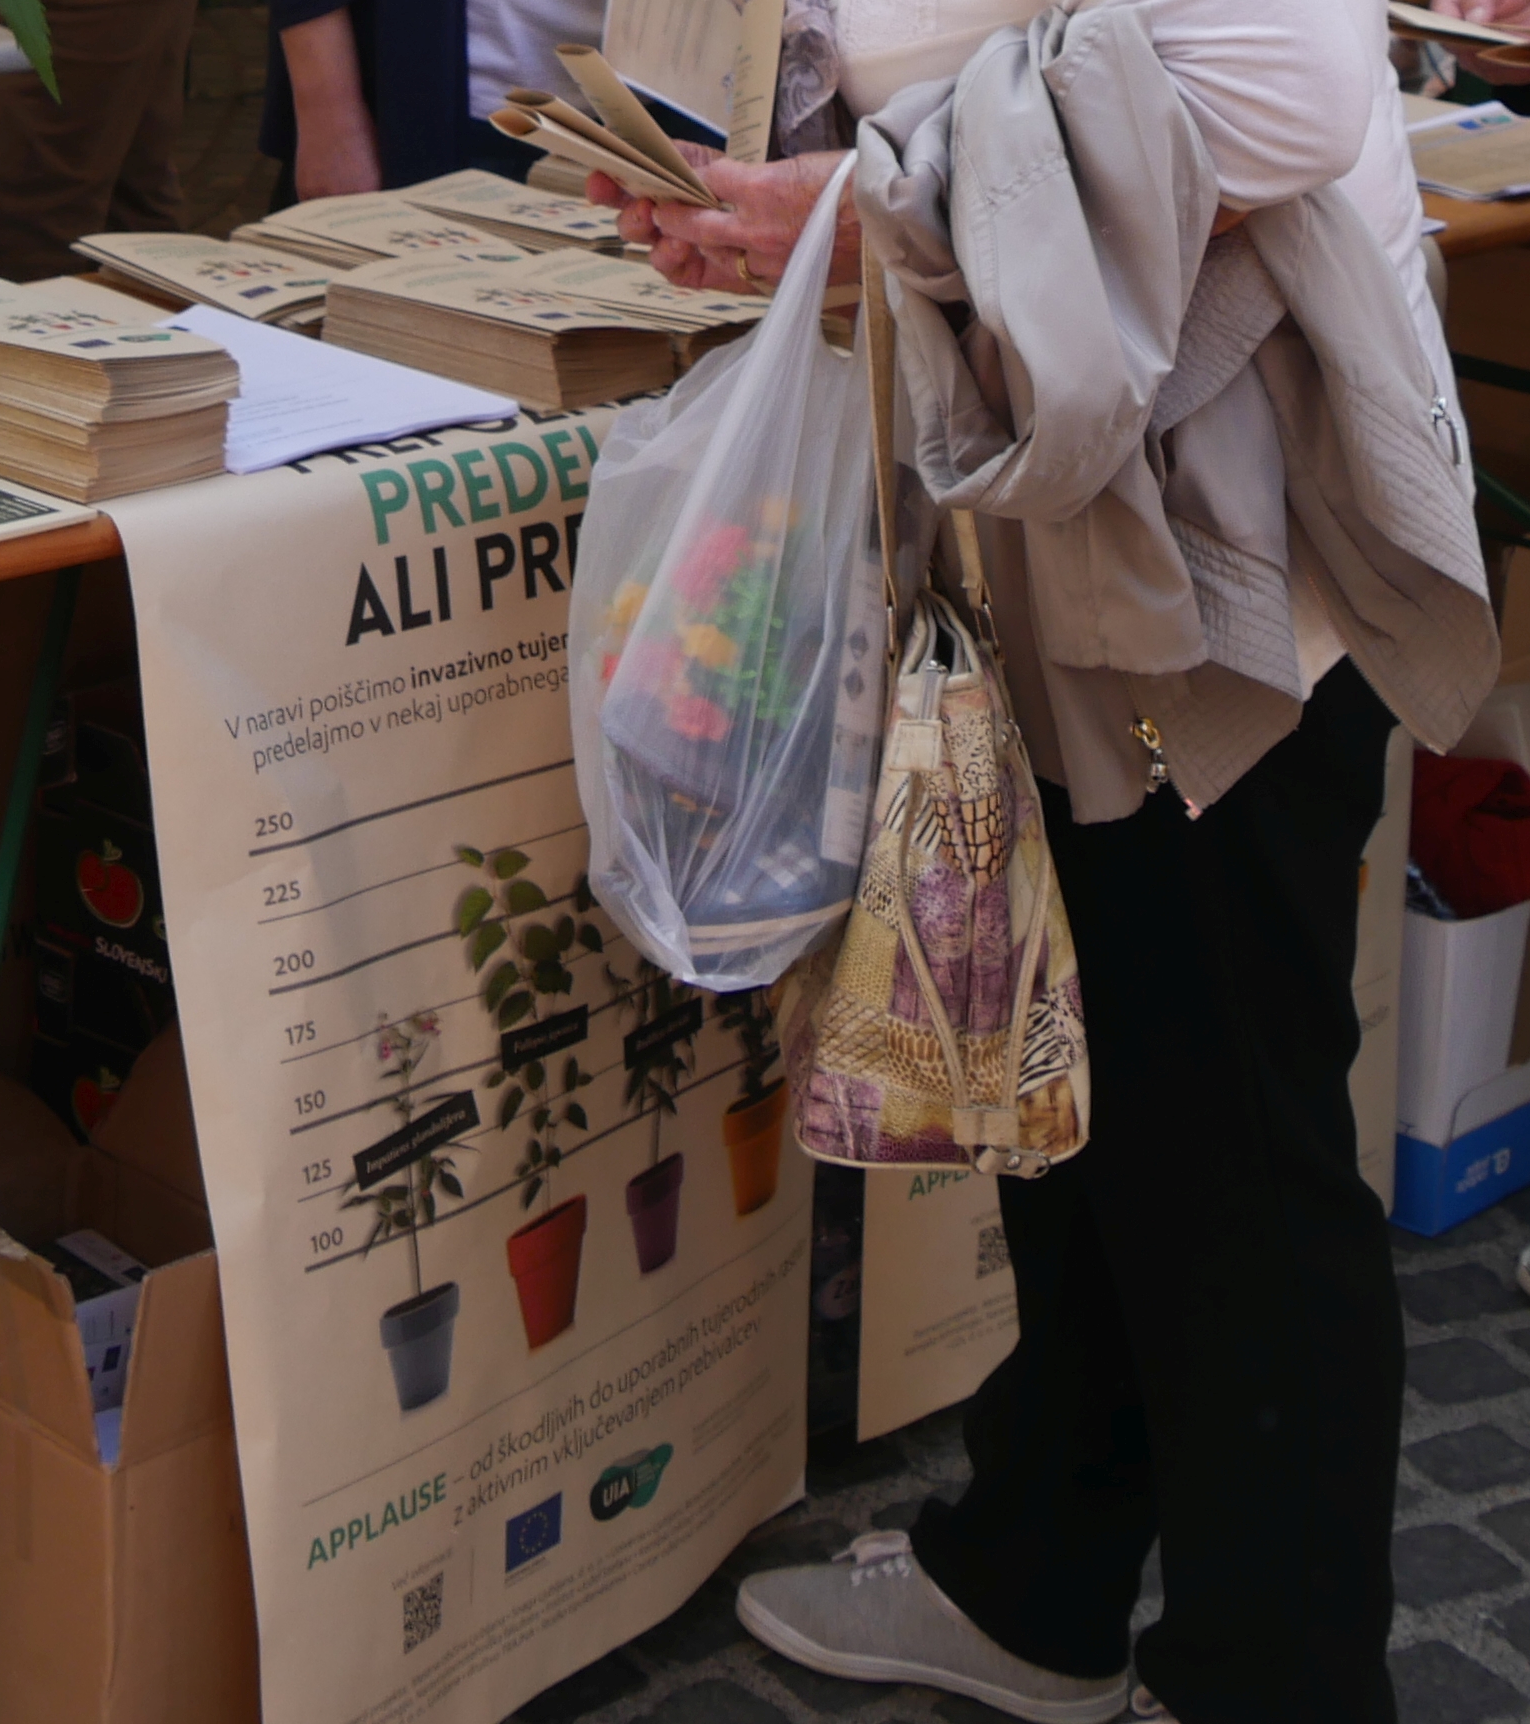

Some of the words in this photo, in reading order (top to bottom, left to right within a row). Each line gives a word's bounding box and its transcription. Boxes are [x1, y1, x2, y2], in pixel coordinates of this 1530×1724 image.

[345, 546, 452, 647] ALI
[225, 716, 242, 740] V
[246, 697, 303, 735] naravi
[310, 674, 406, 722] poiščimo
[410, 645, 513, 690] invazivno
[253, 717, 365, 774] predelajmo
[370, 717, 380, 733] v
[387, 696, 443, 731] nekaj
[448, 665, 569, 714] uporabnega
[254, 811, 294, 838] 250
[263, 880, 302, 907] 225
[273, 949, 316, 976] 200
[284, 1021, 317, 1047] 175
[294, 1089, 326, 1115] 150
[302, 1159, 333, 1185] 125
[310, 1226, 344, 1255] 100
[453, 1506, 464, 1527] z
[467, 1453, 548, 1516] aktivnim
[553, 1376, 676, 1464] vključevanjem
[677, 1316, 762, 1393] prebivalcev
[307, 1472, 447, 1570] APPLAUSE
[469, 1443, 493, 1480] od
[497, 1394, 585, 1463] škodljivih
[589, 1380, 614, 1409] do
[618, 1321, 699, 1393] uporabnih
[602, 1476, 631, 1508] UIA
